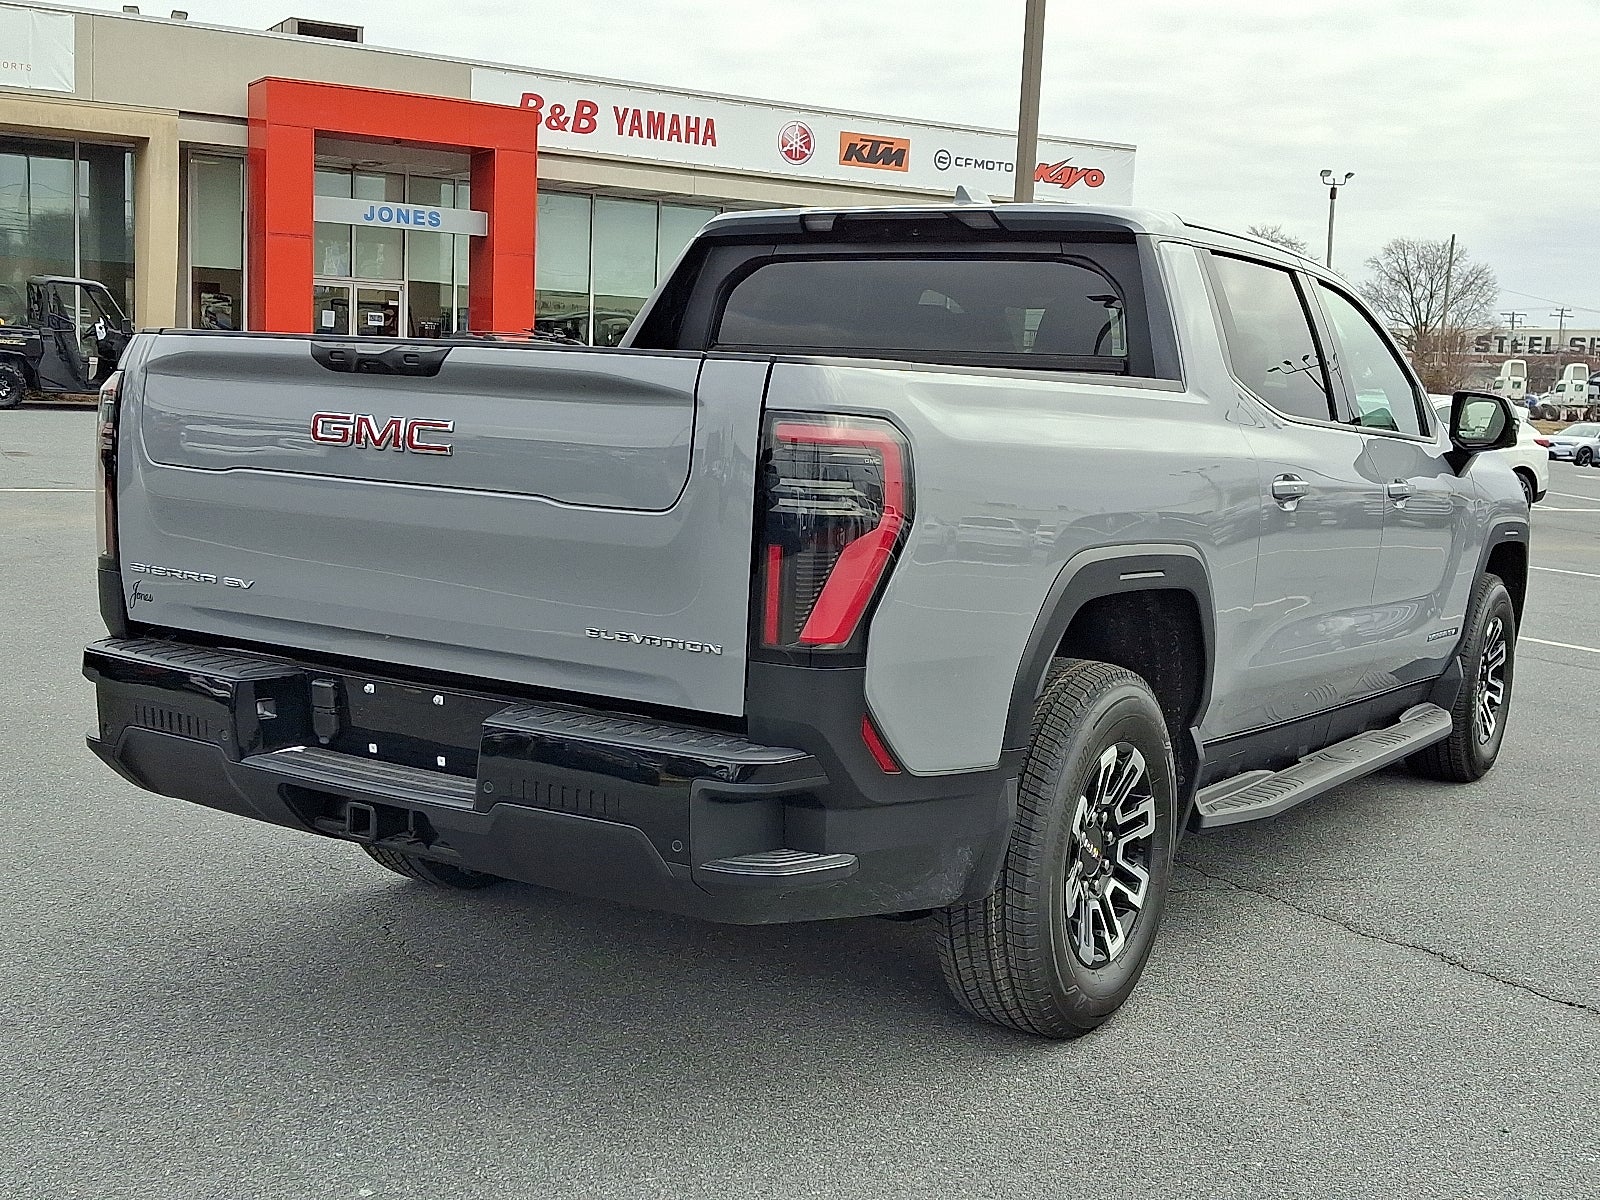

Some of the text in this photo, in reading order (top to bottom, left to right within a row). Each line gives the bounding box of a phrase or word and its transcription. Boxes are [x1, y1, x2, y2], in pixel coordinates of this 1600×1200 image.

[613, 105, 717, 147] YAMAHA
[842, 137, 908, 168] KTM
[954, 157, 1014, 173] CFMOTO
[363, 205, 441, 227] JONES
[1474, 335, 1558, 354] STEEL
[311, 411, 455, 456] GMC
[130, 562, 256, 590] SIERRA EV
[129, 579, 154, 609] Jones
[585, 626, 723, 656] ELEVATION
